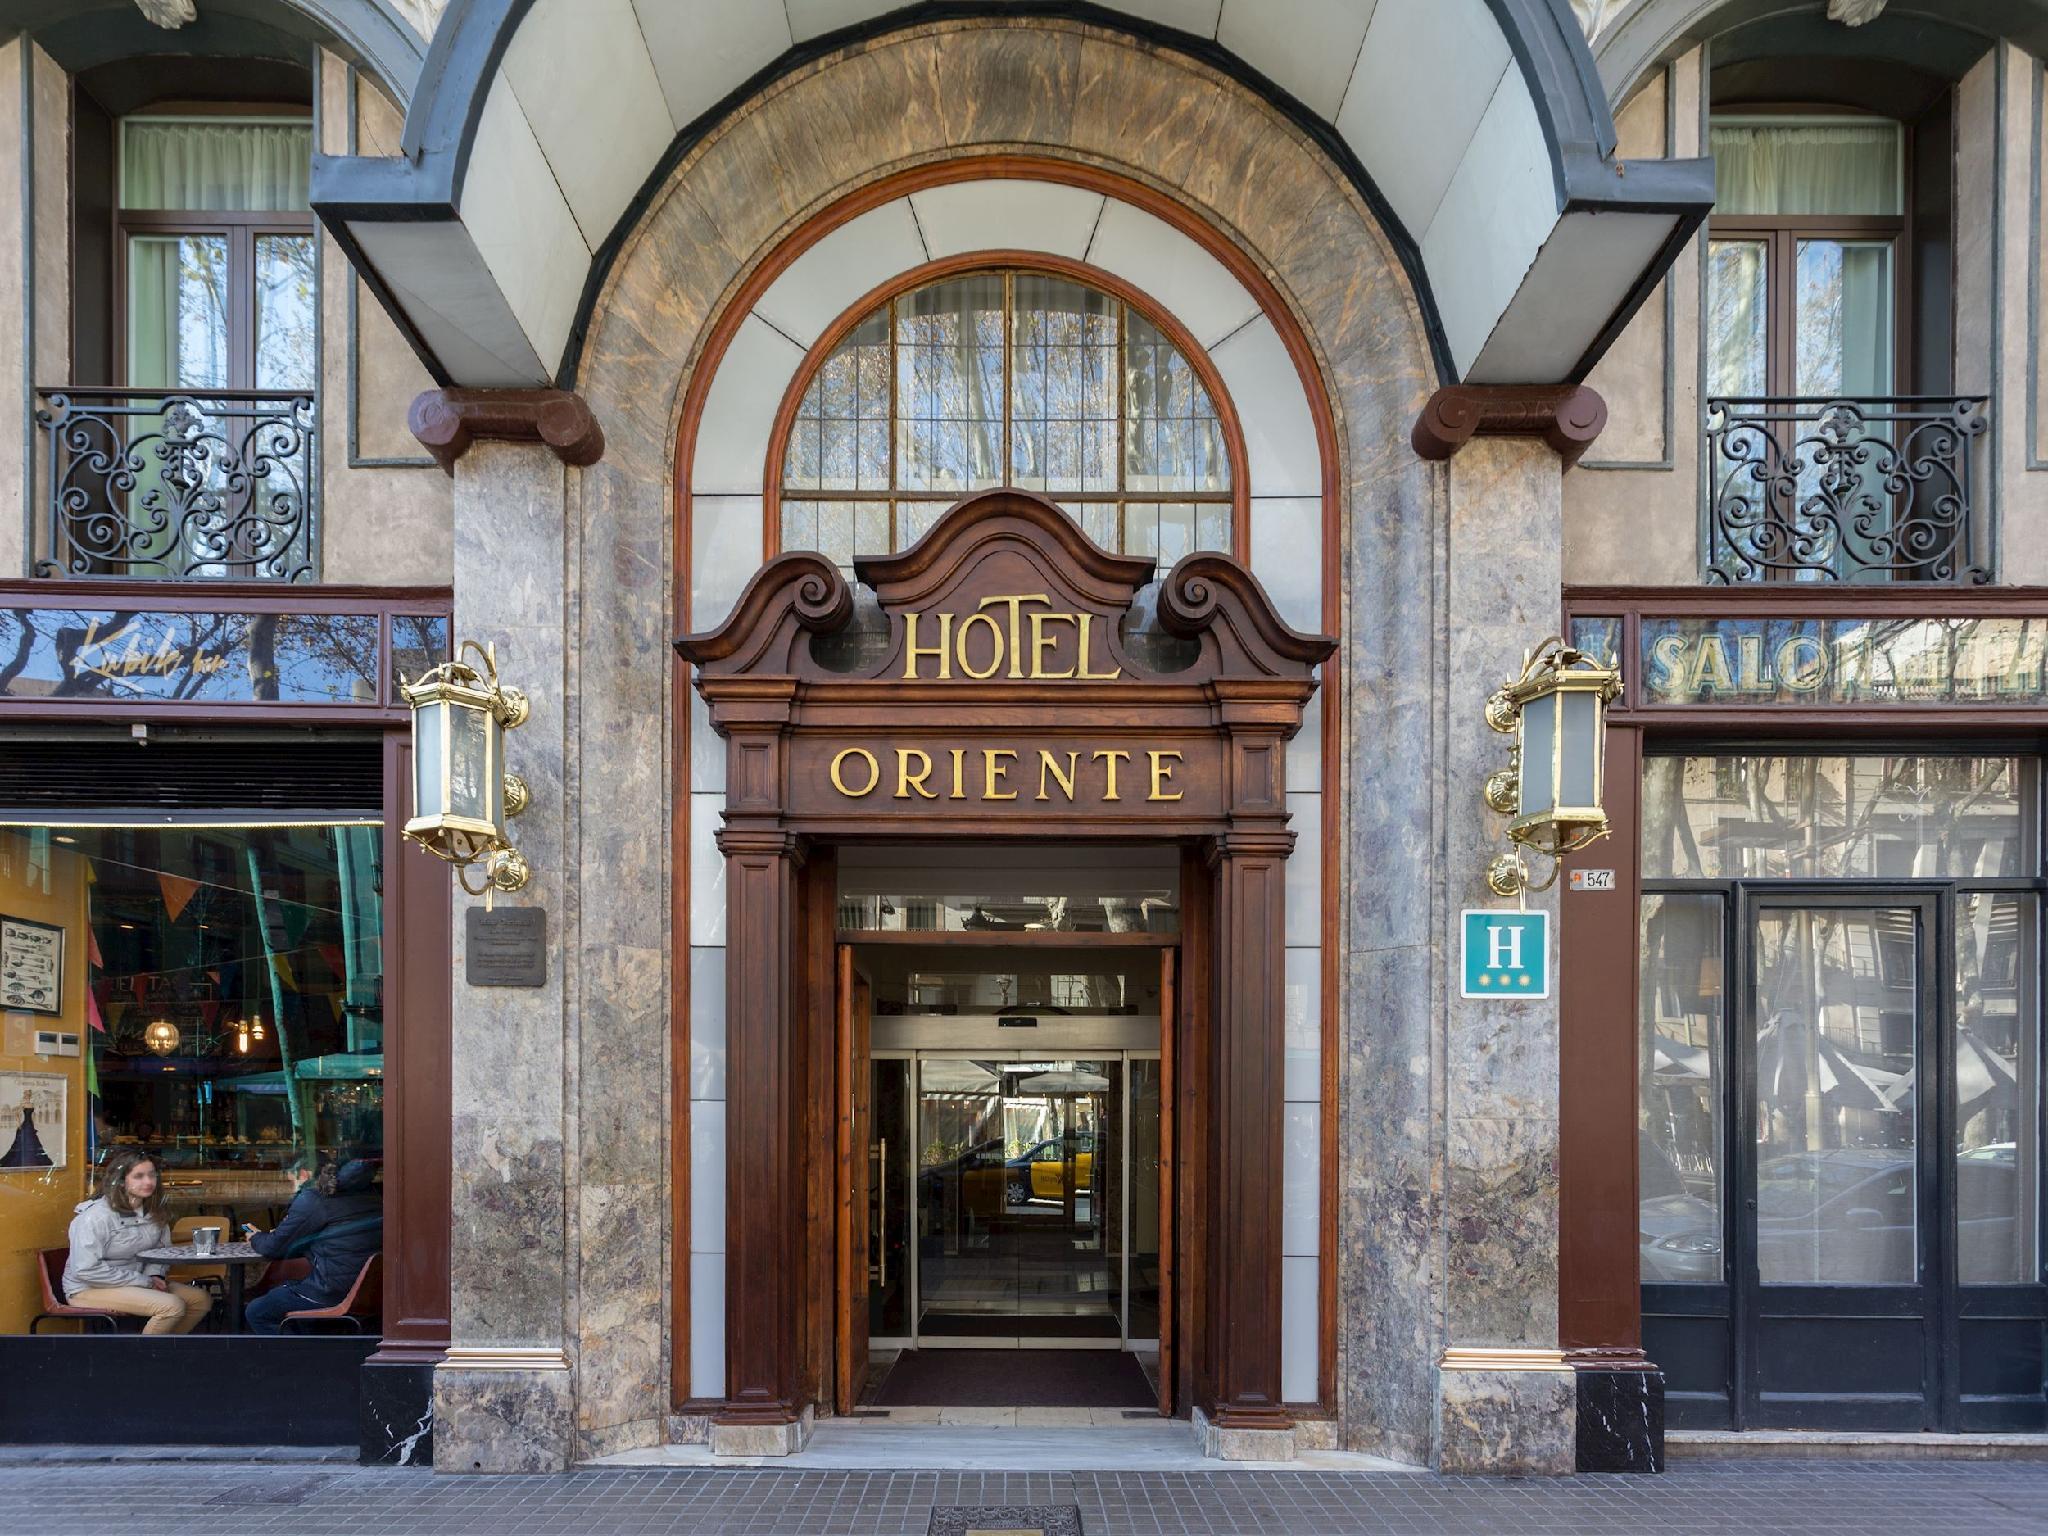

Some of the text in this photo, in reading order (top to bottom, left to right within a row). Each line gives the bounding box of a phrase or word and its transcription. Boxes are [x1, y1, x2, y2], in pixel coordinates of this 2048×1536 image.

[901, 593, 1122, 680] HOTEL
[830, 748, 1185, 801] ORIENTE
[1587, 871, 1610, 887] 547
[1486, 926, 1525, 969] H
